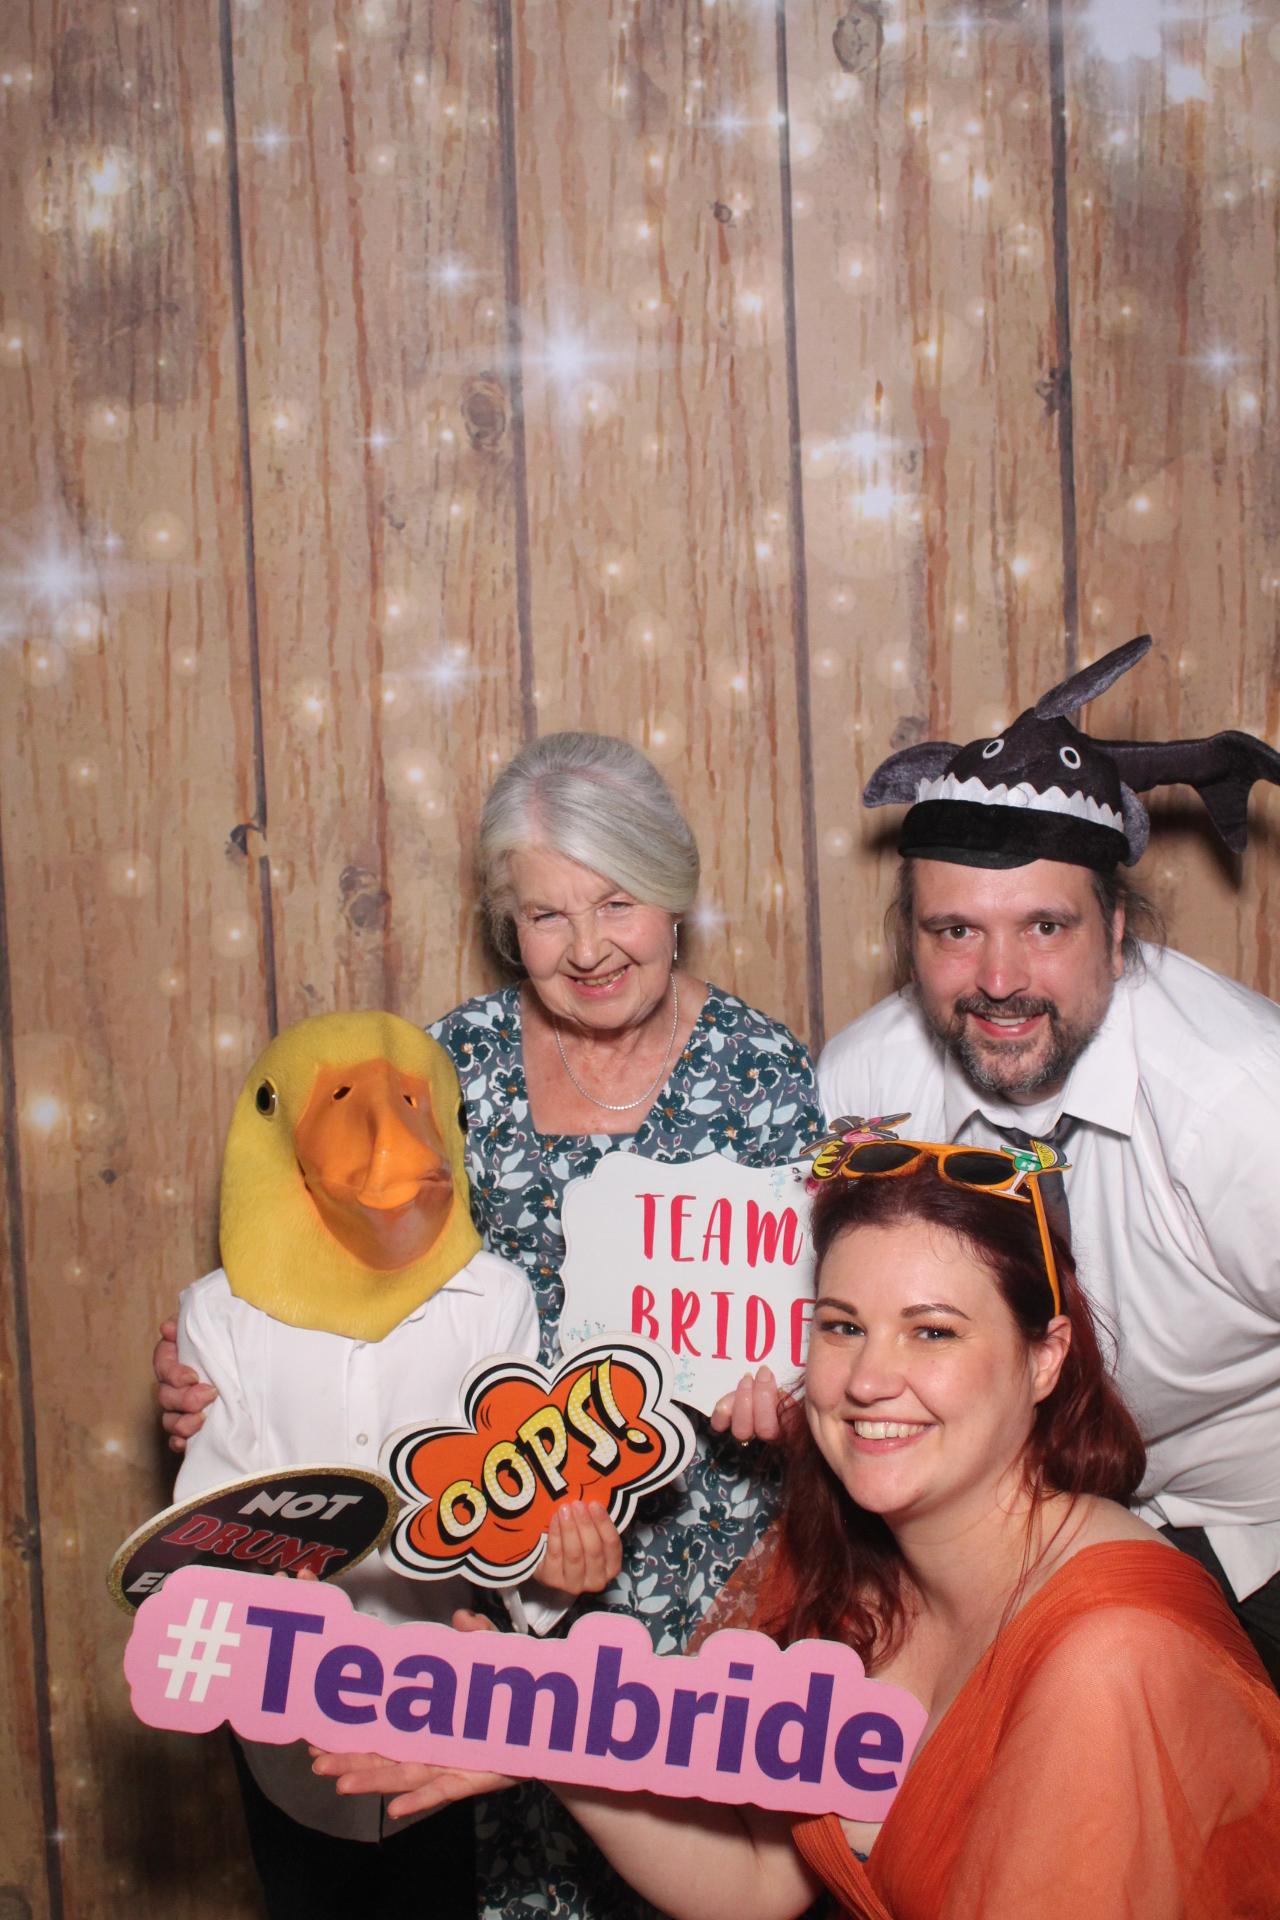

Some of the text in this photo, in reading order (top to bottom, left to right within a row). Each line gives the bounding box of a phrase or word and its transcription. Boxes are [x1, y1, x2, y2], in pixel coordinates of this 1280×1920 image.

[635, 1193, 804, 1268] TEAM
[631, 1284, 816, 1368] BRIDE
[238, 1490, 365, 1521] NOT
[162, 1515, 349, 1577] DRUNK
[157, 1597, 905, 1792] #Teambride
